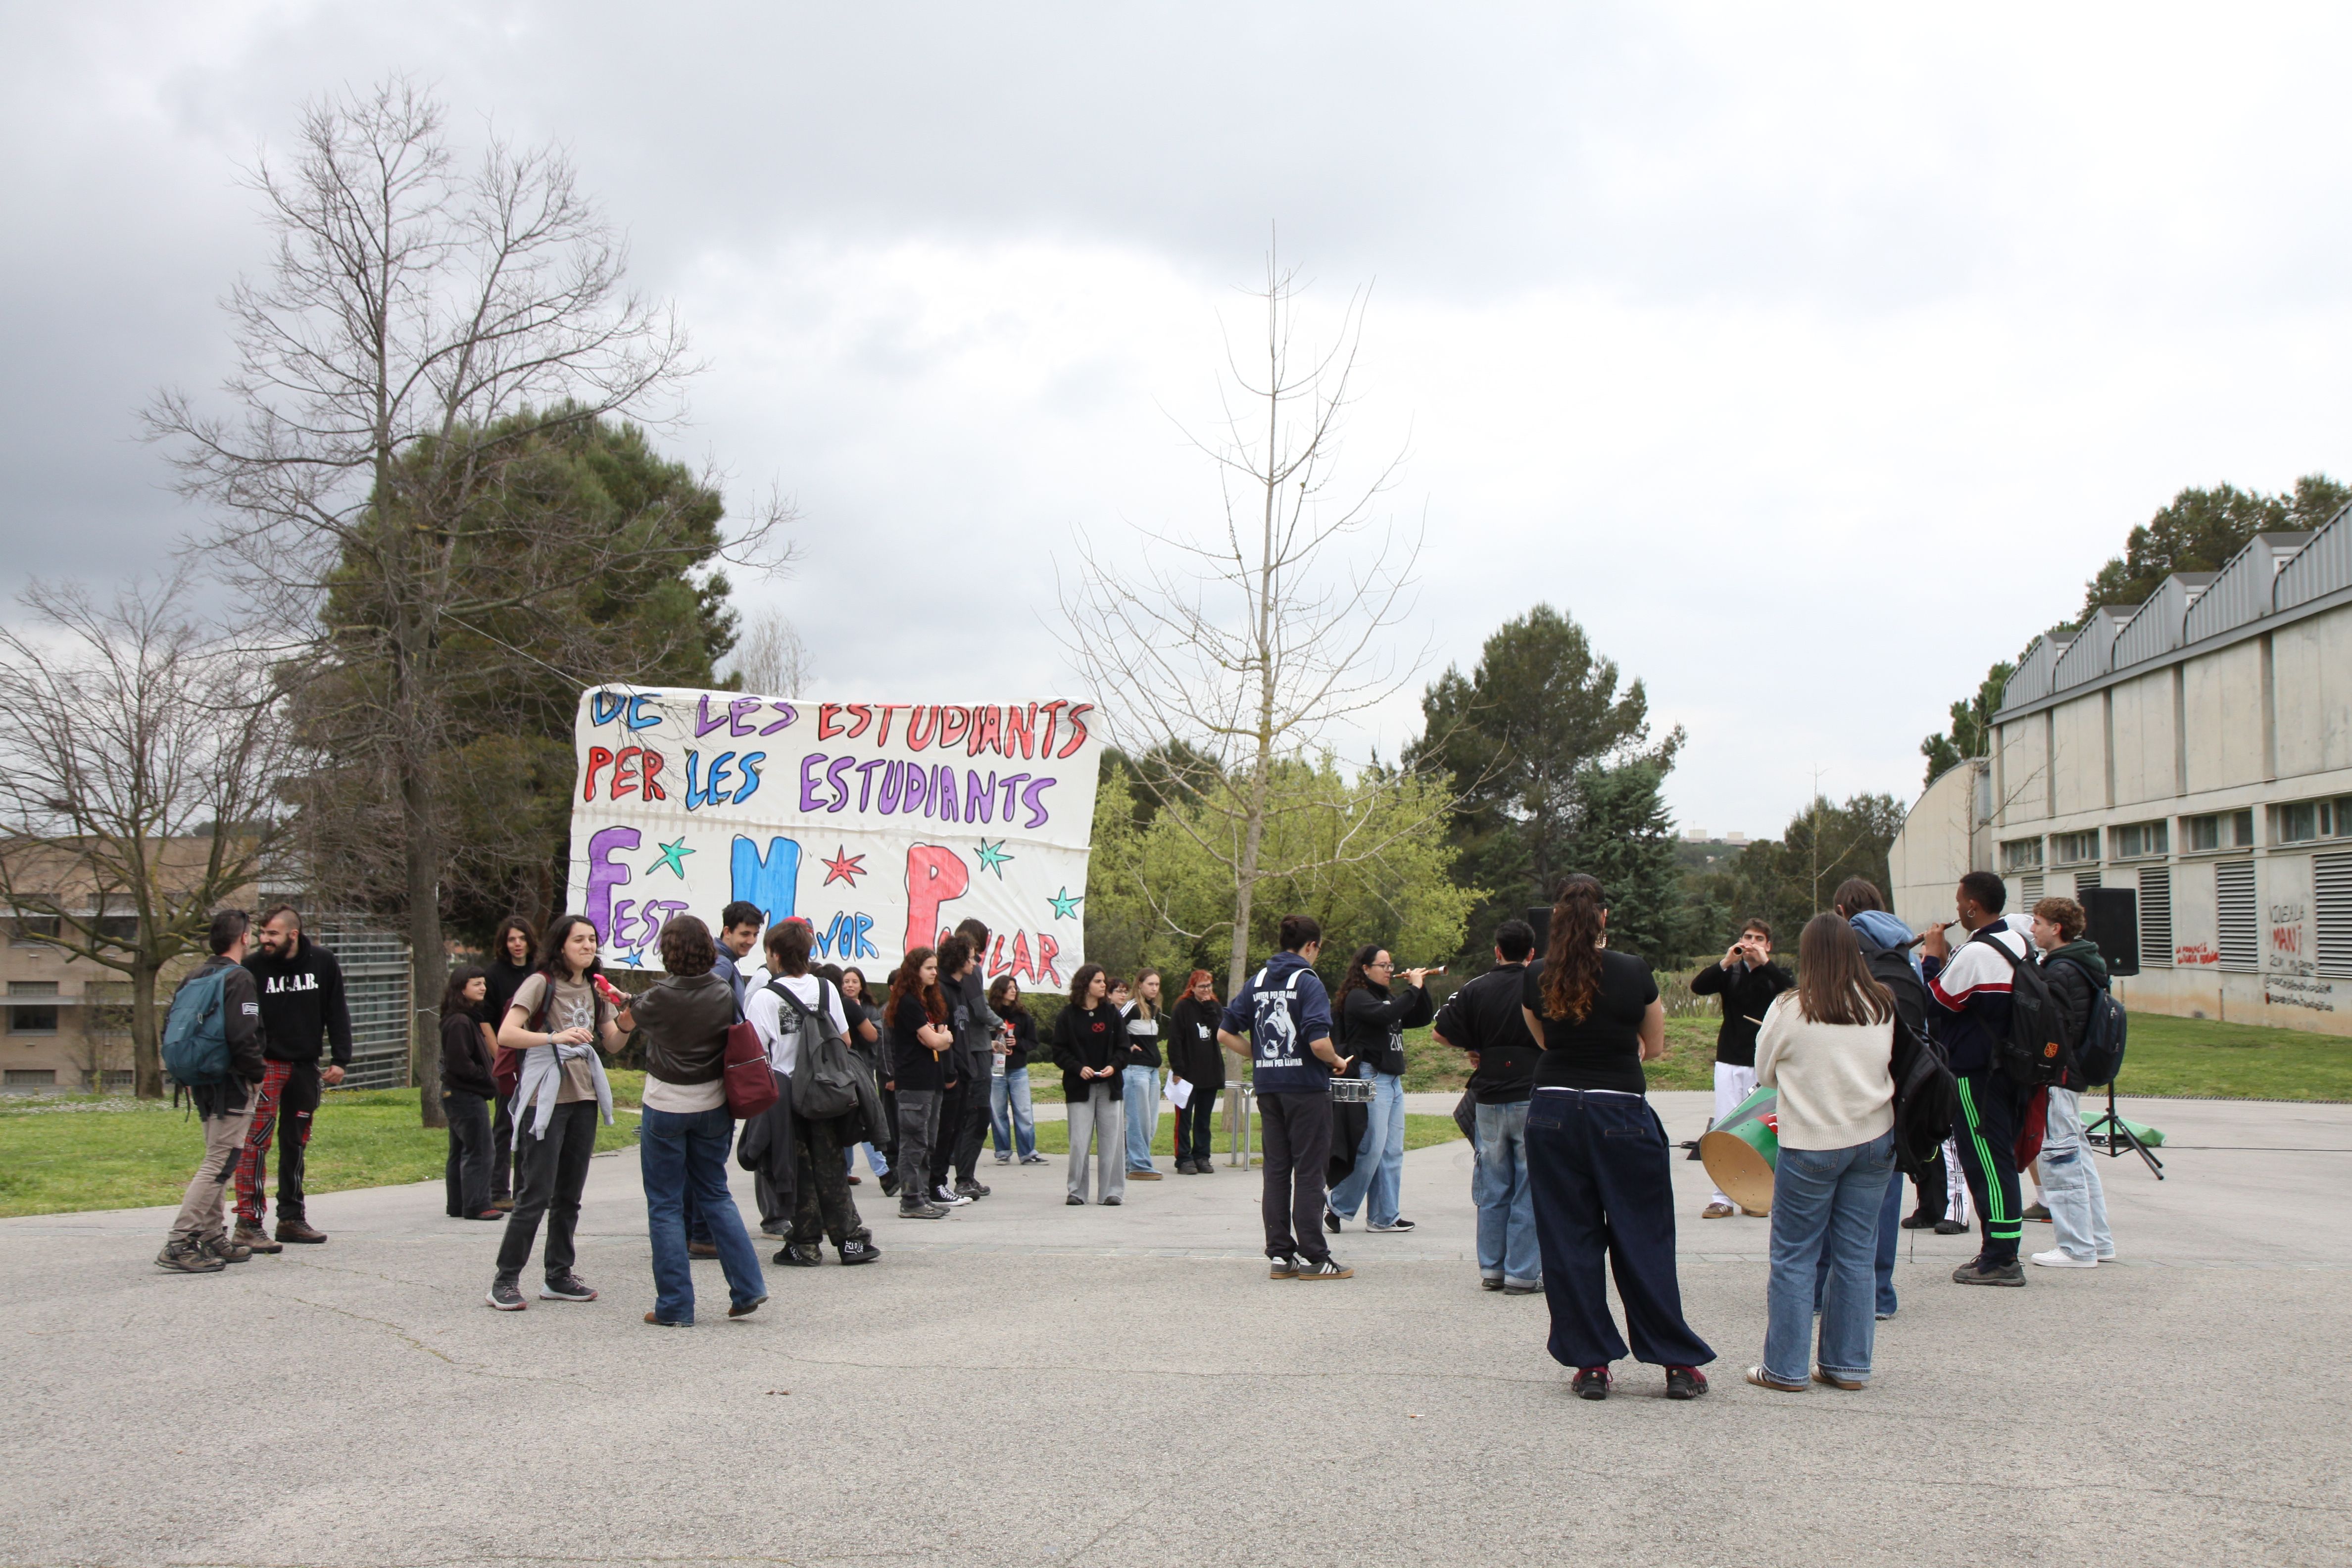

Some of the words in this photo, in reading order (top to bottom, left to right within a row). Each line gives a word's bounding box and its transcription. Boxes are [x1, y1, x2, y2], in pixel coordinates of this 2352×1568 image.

[591, 691, 662, 732] DE
[695, 694, 798, 737] LES
[818, 699, 1094, 759] ESTUDIANTS
[584, 746, 666, 802] PER
[686, 750, 766, 811] LES
[799, 753, 1057, 828] ESTUDIANTS
[584, 826, 691, 955] FEST
[903, 842, 1062, 988] PLAR
[265, 973, 319, 993] A.C.A.B.
